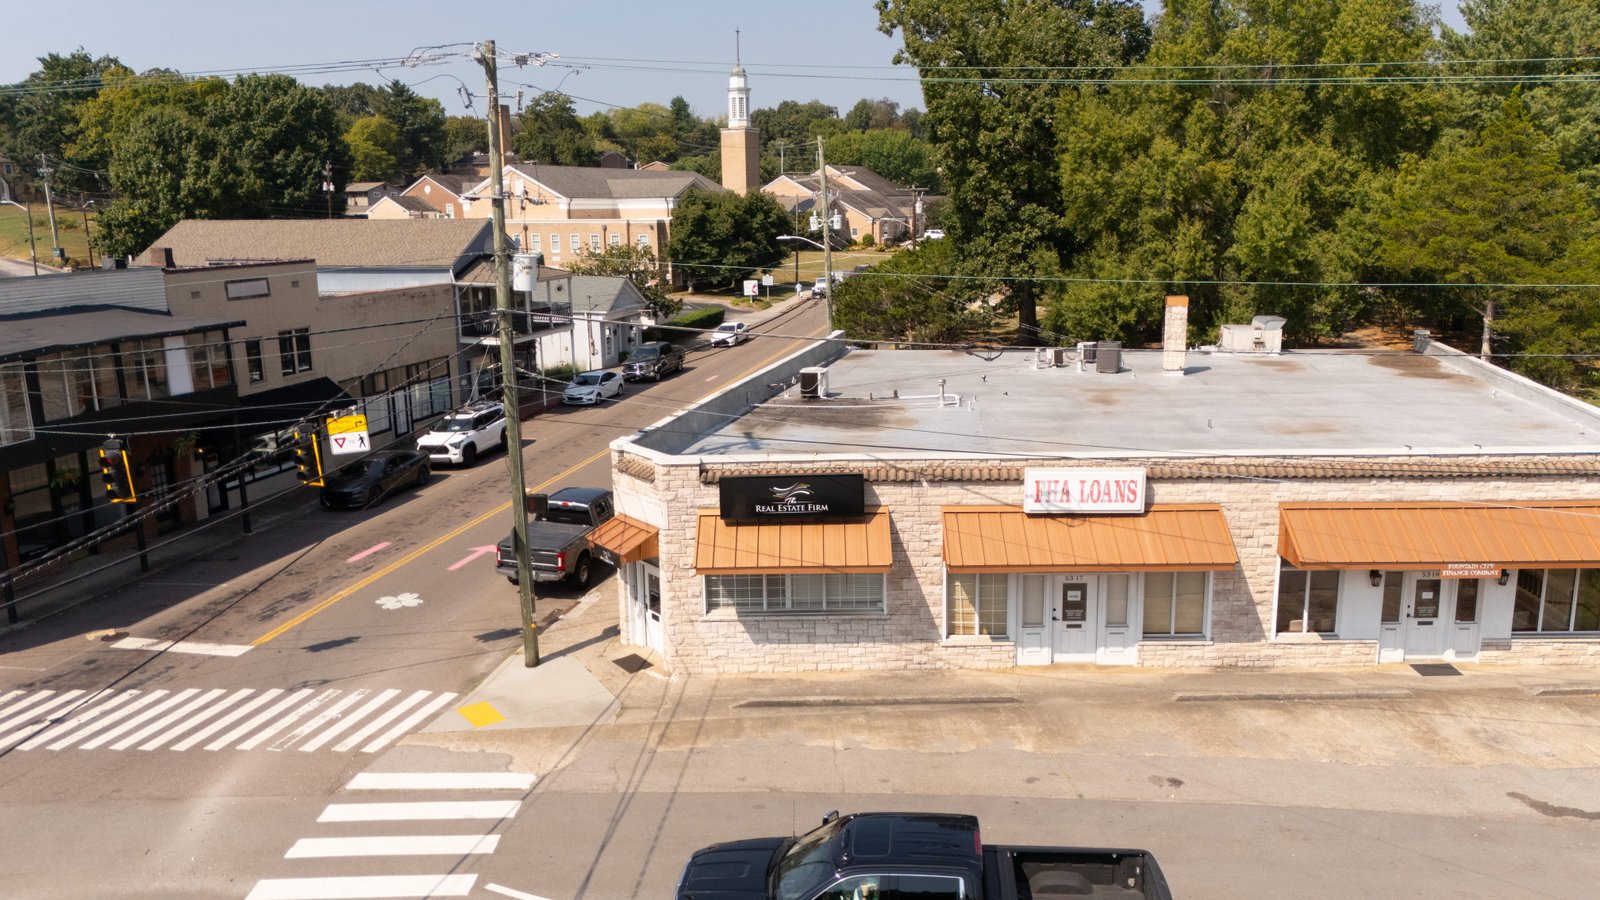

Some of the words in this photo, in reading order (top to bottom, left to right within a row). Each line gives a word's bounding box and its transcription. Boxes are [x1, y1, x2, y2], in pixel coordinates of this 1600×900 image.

[1079, 479, 1138, 503] LOANS
[755, 504, 776, 512] REAL
[777, 504, 806, 512] ESTATE
[808, 503, 829, 511] FIRM
